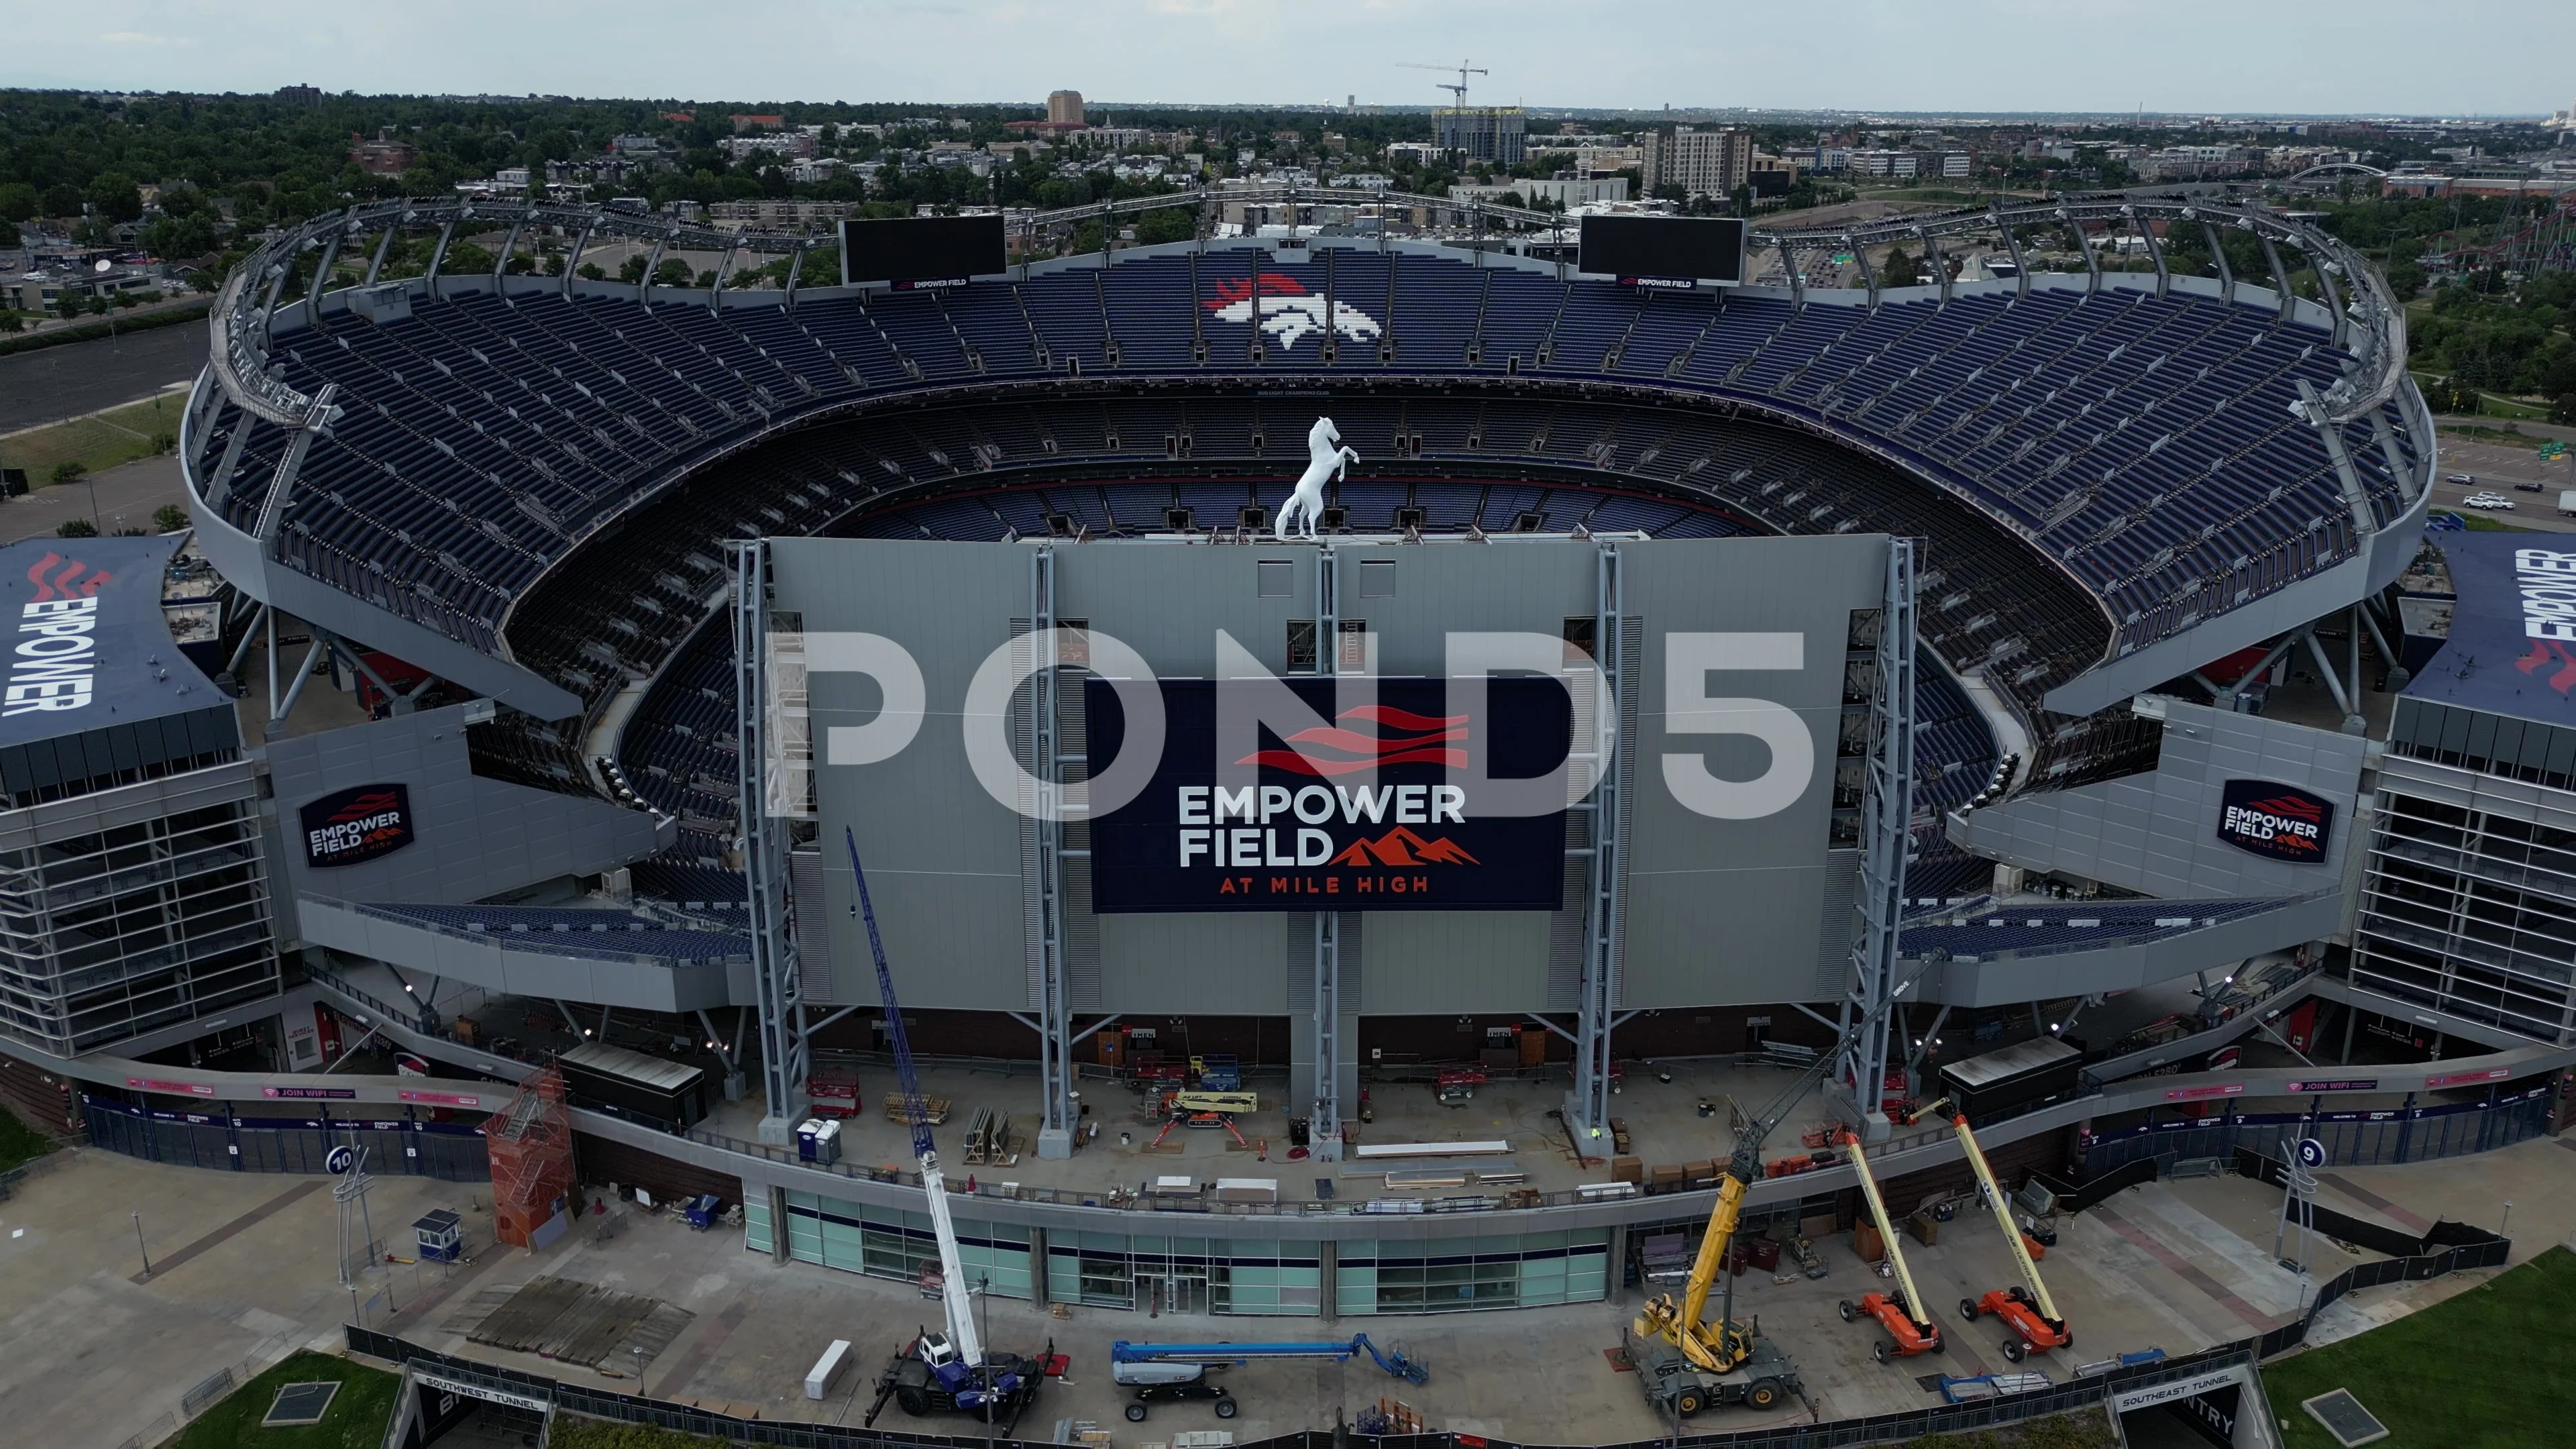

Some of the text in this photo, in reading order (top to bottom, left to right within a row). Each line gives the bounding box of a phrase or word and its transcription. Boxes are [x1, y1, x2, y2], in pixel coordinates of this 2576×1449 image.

[914, 280, 947, 288] EMPOWER
[1638, 278, 1671, 286] EMPOWER
[2515, 549, 2576, 642] EMPOWER
[2, 596, 98, 717] EMPOWER
[1179, 786, 1466, 825] EMPOWER
[309, 811, 400, 845] EMPOWER
[2224, 818, 2274, 840] FIELD
[2226, 805, 2318, 839] EMPOWER
[312, 834, 362, 857] FIELD
[342, 847, 365, 858] MILE
[370, 841, 392, 851] HIGH
[1179, 829, 1334, 867] FIELD
[2251, 839, 2274, 849] MILE
[2277, 845, 2302, 856] HIGH
[1220, 875, 1429, 894] AT MILE HIGH
[288, 1028, 314, 1038] SERVICES
[292, 1026, 310, 1034] GUEST
[332, 1152, 352, 1171] 10
[2304, 1146, 2314, 1161] 9
[2028, 1276, 2042, 1300] BOOM
[426, 1377, 539, 1410] SOUTHWEST TUNNEL
[2122, 1375, 2232, 1407] SOUTHEAST TUNNEL
